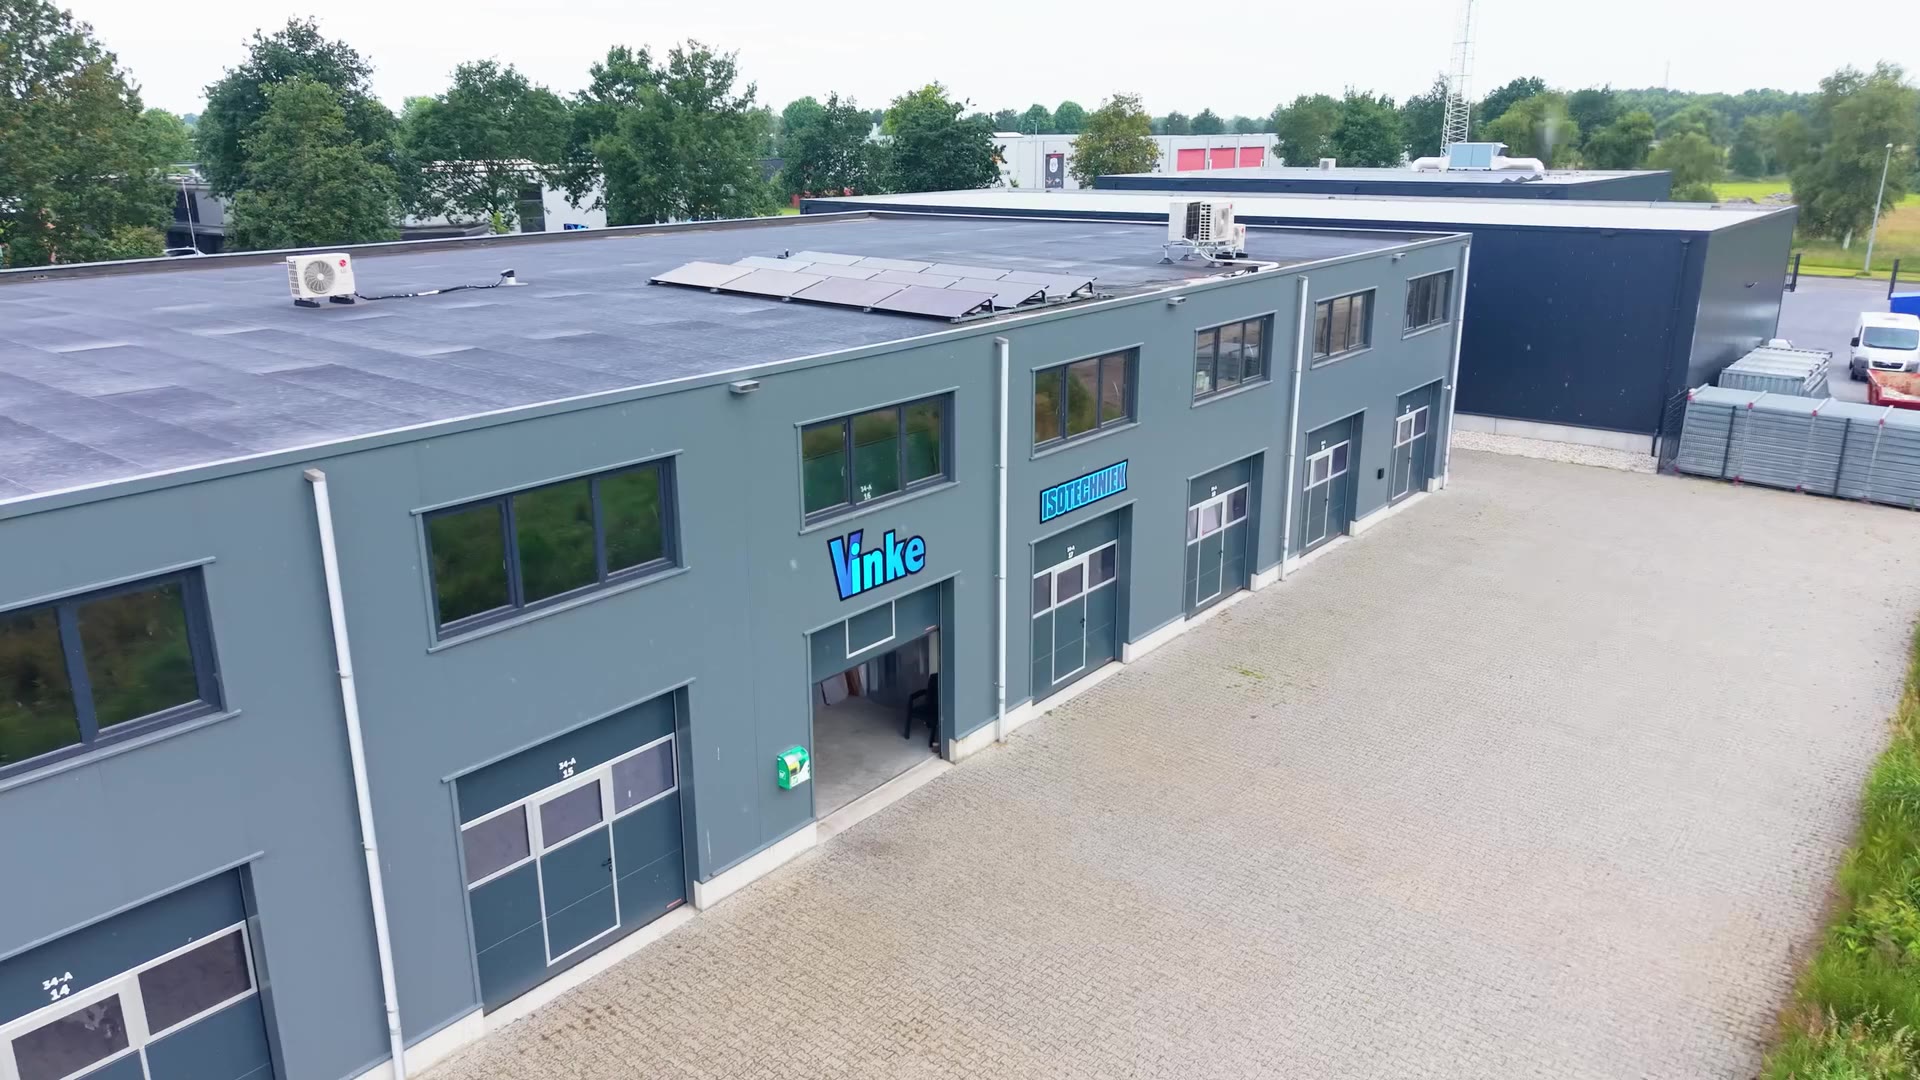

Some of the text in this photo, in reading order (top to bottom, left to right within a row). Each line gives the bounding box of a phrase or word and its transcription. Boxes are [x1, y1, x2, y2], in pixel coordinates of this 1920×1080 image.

[1041, 460, 1127, 522] ISOTECHNIEK
[827, 528, 926, 601] Vinke
[558, 757, 576, 770] 34-A
[562, 766, 574, 778] 15
[42, 971, 73, 990] 34-A
[50, 983, 70, 1000] 14
